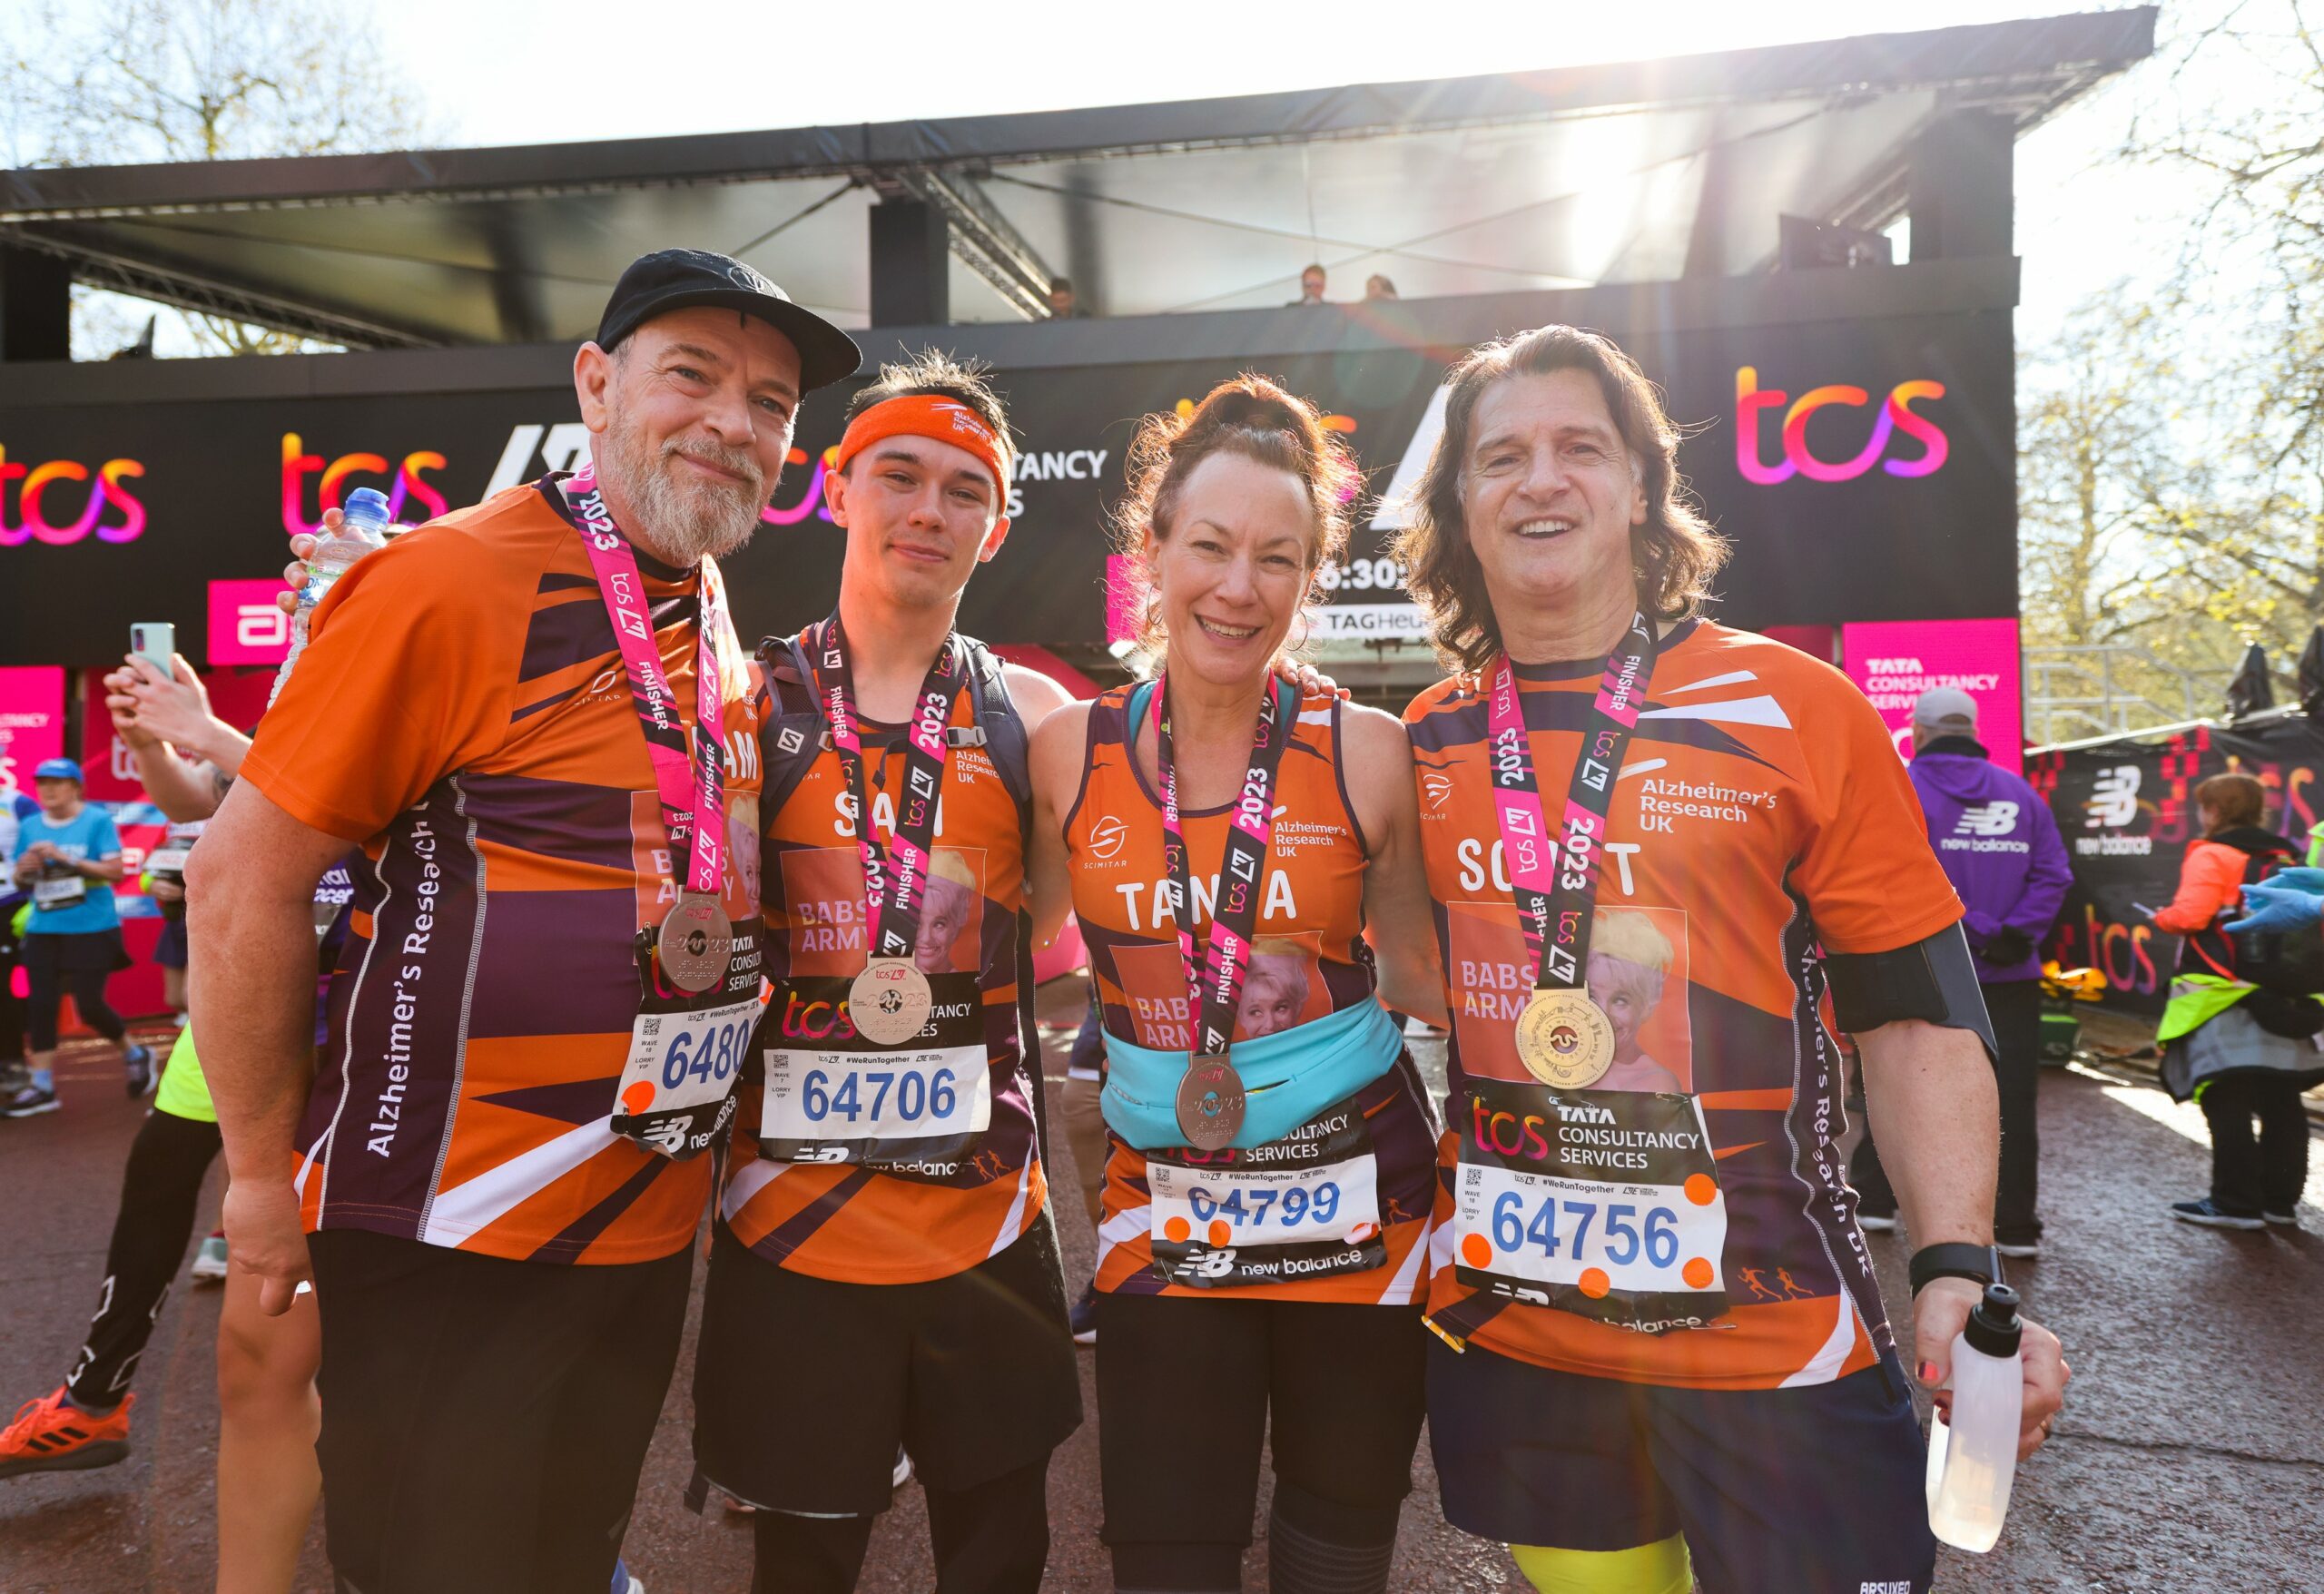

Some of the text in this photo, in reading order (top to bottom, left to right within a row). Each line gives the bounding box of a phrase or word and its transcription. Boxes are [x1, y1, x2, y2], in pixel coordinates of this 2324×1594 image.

[953, 422, 965, 434] UK
[1736, 366, 1949, 485] tcs
[282, 432, 448, 536] tcs
[579, 489, 619, 551] 2023
[610, 572, 634, 605] tcs
[638, 661, 669, 730] FINISHER
[827, 619, 838, 649] tcs
[933, 652, 954, 678] tcs
[1866, 658, 1924, 674] TATA
[1610, 655, 1641, 712] FINISHER
[1866, 674, 2000, 691] CONSULTANCY
[703, 694, 716, 723] tcs
[830, 685, 848, 740] FINISHER
[1496, 690, 1512, 719] tcs
[918, 693, 948, 750] 2023
[956, 750, 992, 767] Alzhei
[1497, 727, 1525, 785] 2023
[1593, 730, 1621, 759] tcs
[704, 743, 715, 810] FINISHER
[956, 760, 1000, 779] Researc
[958, 772, 975, 784] UK
[1238, 767, 1268, 830] 2023
[1640, 779, 1777, 809] Alzheimer's
[1640, 795, 1748, 822] Research
[833, 791, 943, 838] SA
[904, 799, 927, 828] tcs
[1640, 814, 1674, 833] UK
[1275, 821, 1347, 837] Alzheimer's
[1275, 833, 1334, 847] Research
[1276, 847, 1297, 858] UK
[1517, 839, 1539, 874] tcs
[1561, 818, 1595, 890] 2023
[1941, 838, 2030, 853] new balance
[2075, 835, 2152, 856] new balance
[895, 848, 918, 910] FINISHER
[1084, 859, 1128, 871] SCIMITAR
[1457, 838, 1641, 896] SCT
[1116, 869, 1297, 931] TANA
[1224, 882, 1247, 914] tcs
[1557, 910, 1582, 944] tcs
[732, 935, 754, 952] TATA
[876, 969, 890, 979] tcs
[1216, 936, 1238, 1005] FINISHER
[710, 1005, 749, 1018] #WeRunTogether
[782, 990, 856, 1038] tcs
[1136, 997, 1190, 1020] BAB
[367, 964, 422, 1158] Alzheimer's
[662, 1013, 761, 1089] 6480
[846, 1057, 911, 1066] #WeRunTogether
[803, 1068, 956, 1122] 64706
[1472, 1097, 1617, 1160] tcs TATA
[1558, 1127, 1700, 1150] CONSULTANCY
[1246, 1143, 1319, 1163] SERVICES
[1560, 1147, 1649, 1169] SERVICES
[892, 1160, 960, 1176] balanc
[1228, 1174, 1294, 1183] #WeRunTogether
[1542, 1178, 1615, 1194] #WeRunTogether
[1492, 1191, 1679, 1268] 64756
[1241, 1249, 1363, 1276] new balance
[1847, 1232, 1870, 1279] UK
